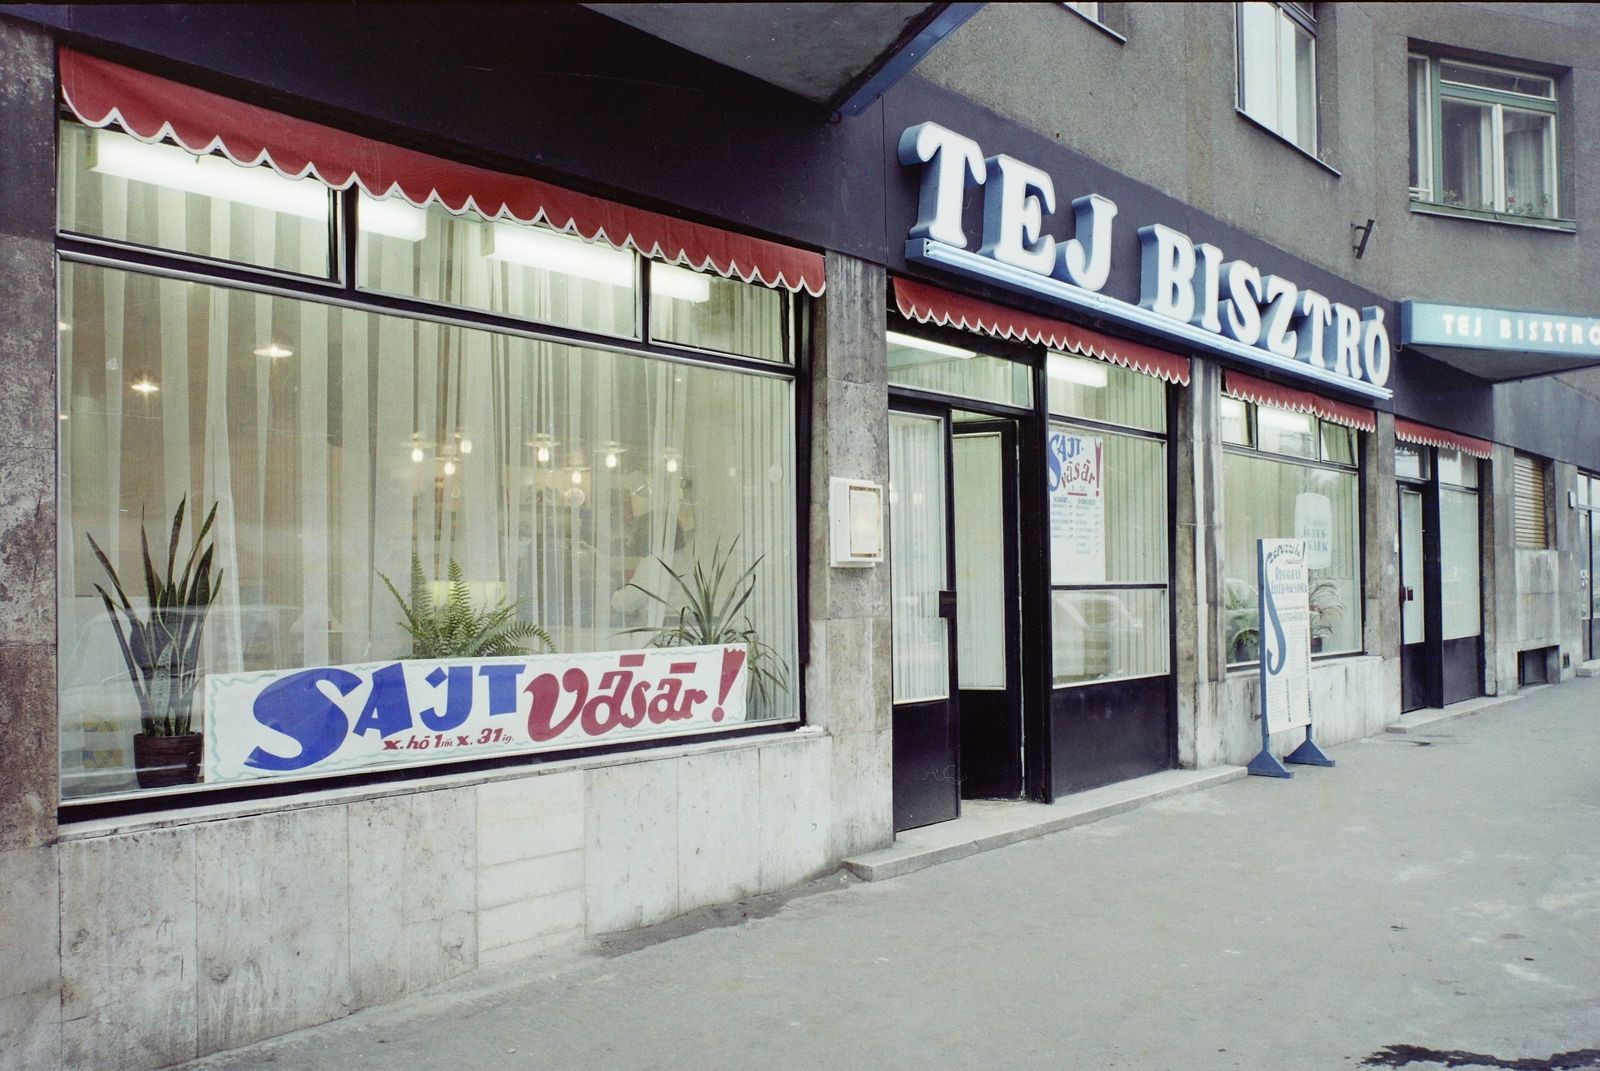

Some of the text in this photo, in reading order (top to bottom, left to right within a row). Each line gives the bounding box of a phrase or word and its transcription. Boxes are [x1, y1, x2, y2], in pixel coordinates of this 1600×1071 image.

[898, 120, 1390, 387] TEJ BISZTRÓ
[1442, 313, 1600, 346] TEJ BISZTRÓ
[1308, 540, 1328, 551] ELEK
[243, 661, 526, 771] SAJT
